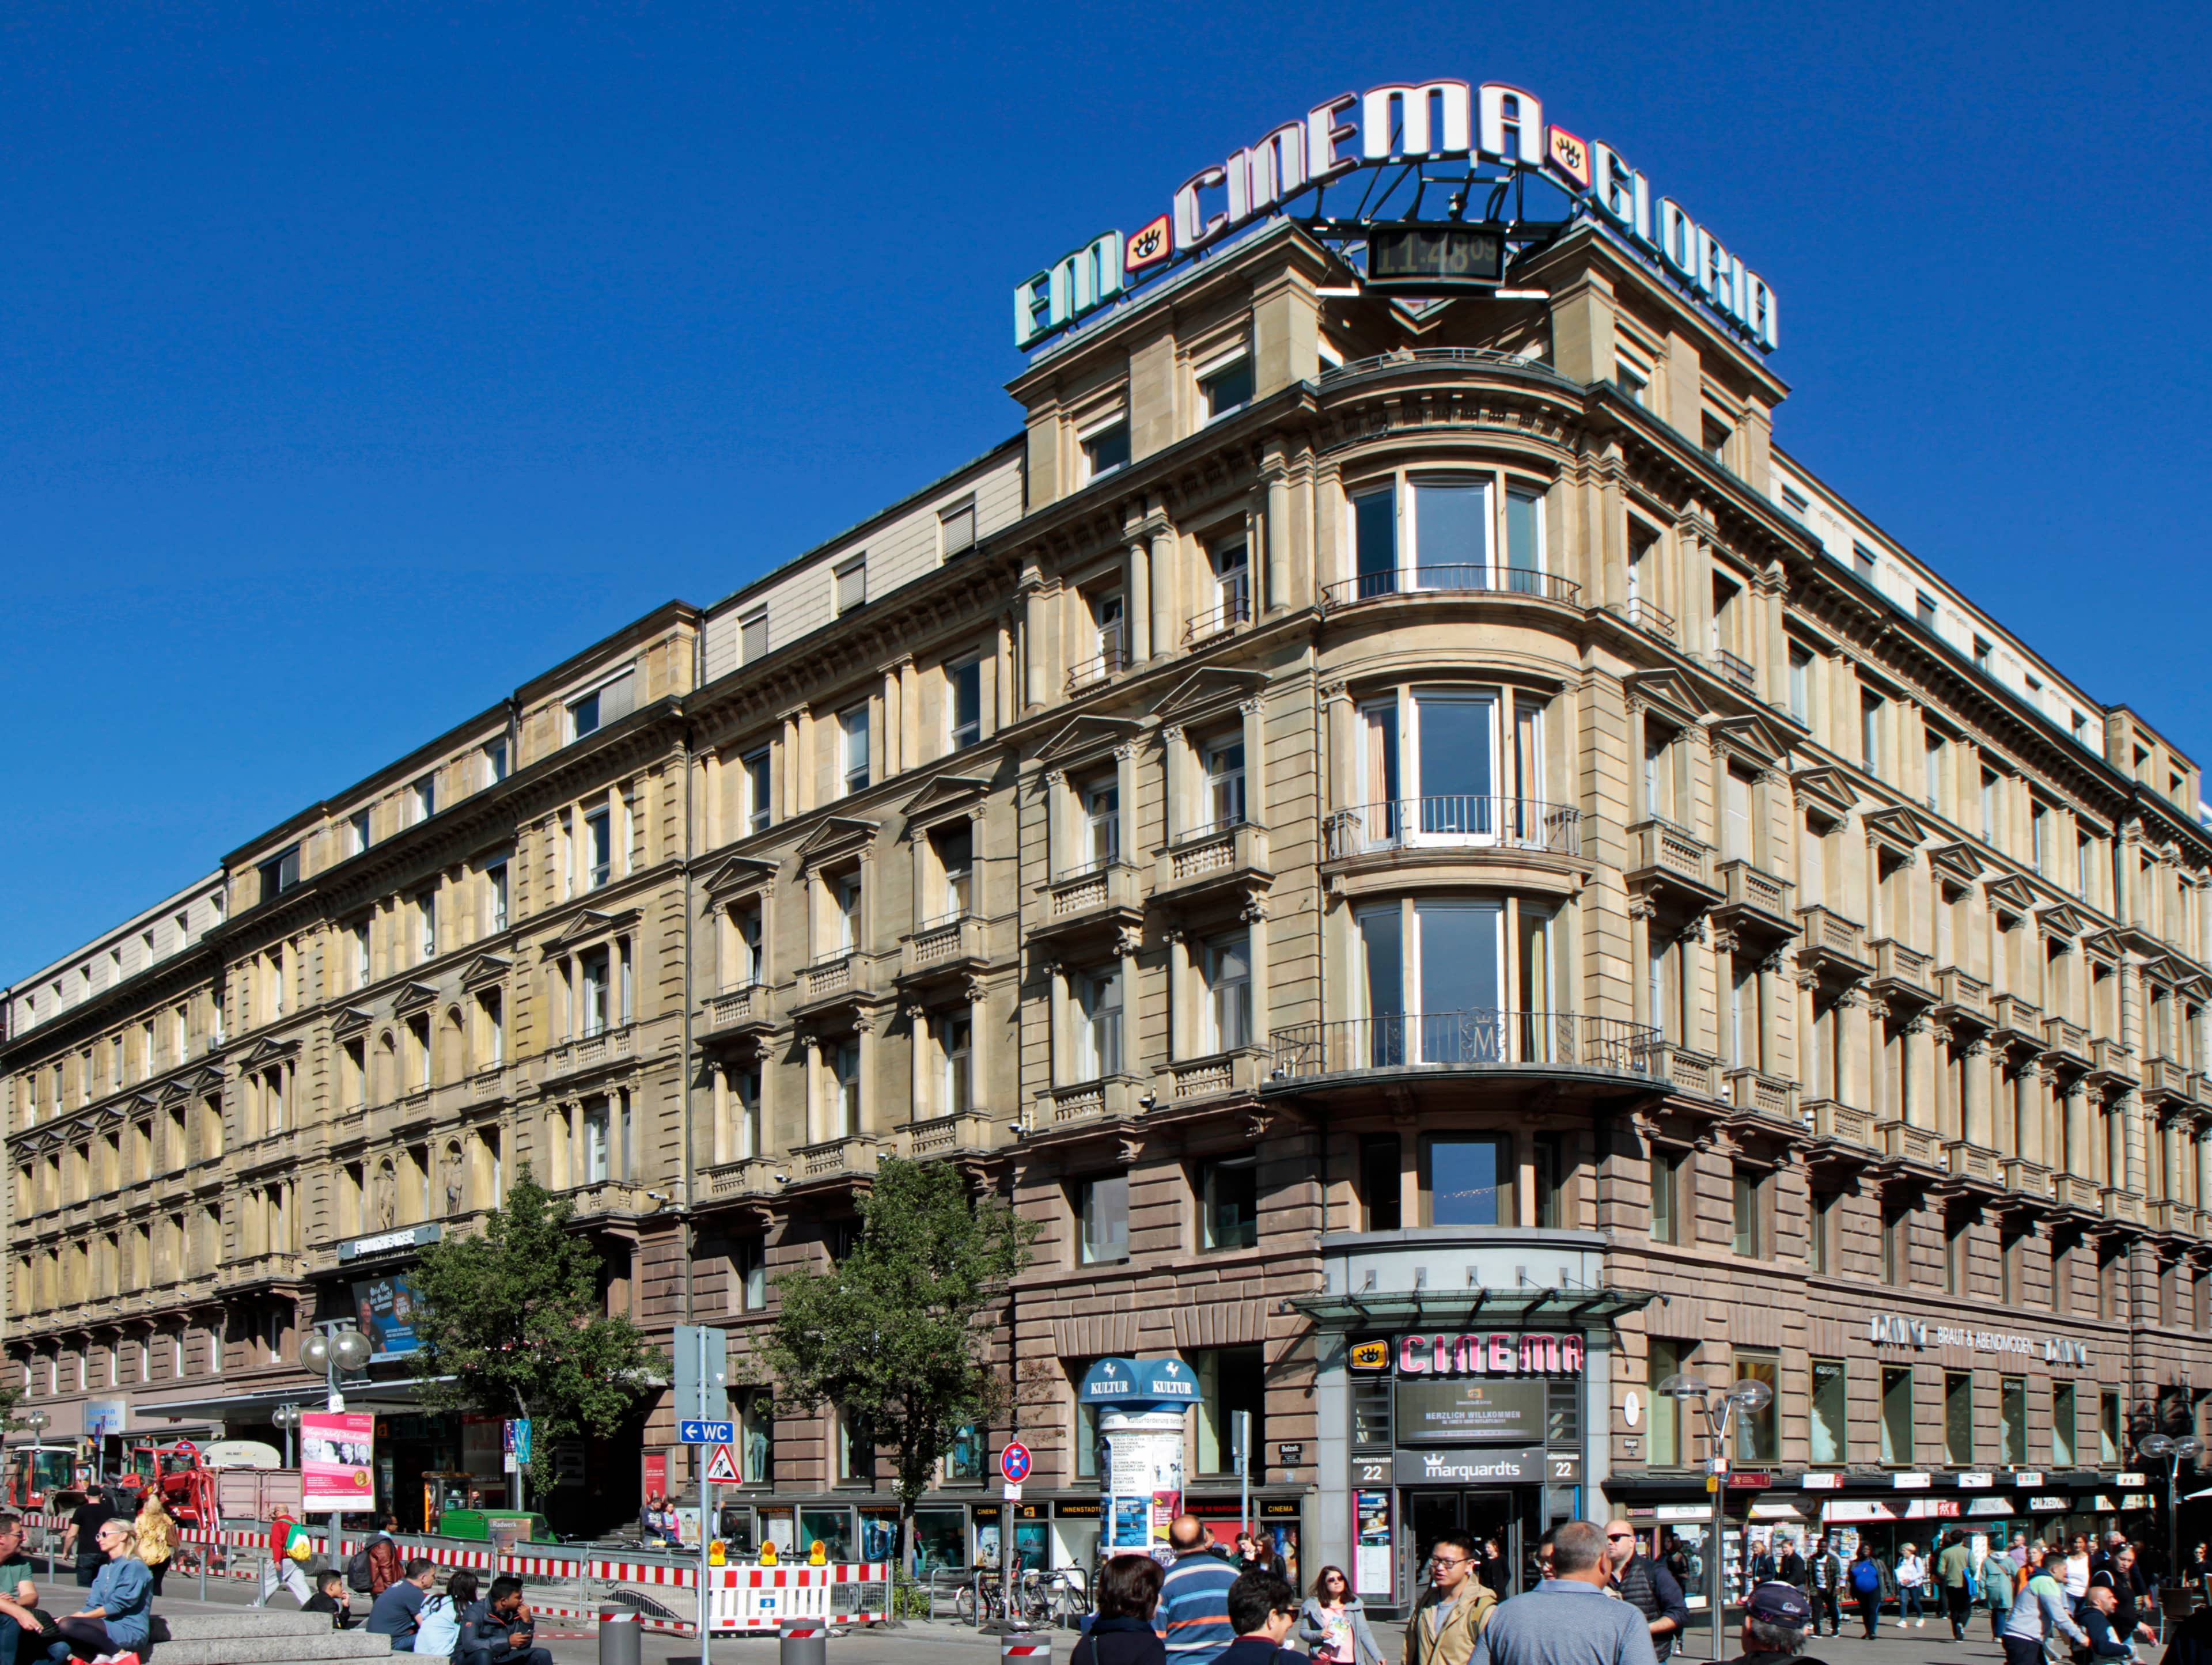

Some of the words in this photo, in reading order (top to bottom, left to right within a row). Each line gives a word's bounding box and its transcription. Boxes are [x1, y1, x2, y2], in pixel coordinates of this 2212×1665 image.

[1173, 79, 1544, 253] CINEMA
[1588, 139, 1779, 356] GLORIA
[1937, 1326, 1964, 1346] BRAUT
[1965, 1330, 1972, 1347] &
[1975, 1331, 2034, 1354] ABENDMODEN
[1400, 1334, 1583, 1372] CINEMA
[1090, 1380, 1128, 1395] KULTUR
[1153, 1380, 1192, 1394] KULTUR
[1426, 1412, 1465, 1420] HERZLICH
[702, 1424, 728, 1440] WC
[1363, 1466, 1382, 1480] 22
[1426, 1461, 1521, 1481] marquardts
[1556, 1463, 1571, 1477] 22
